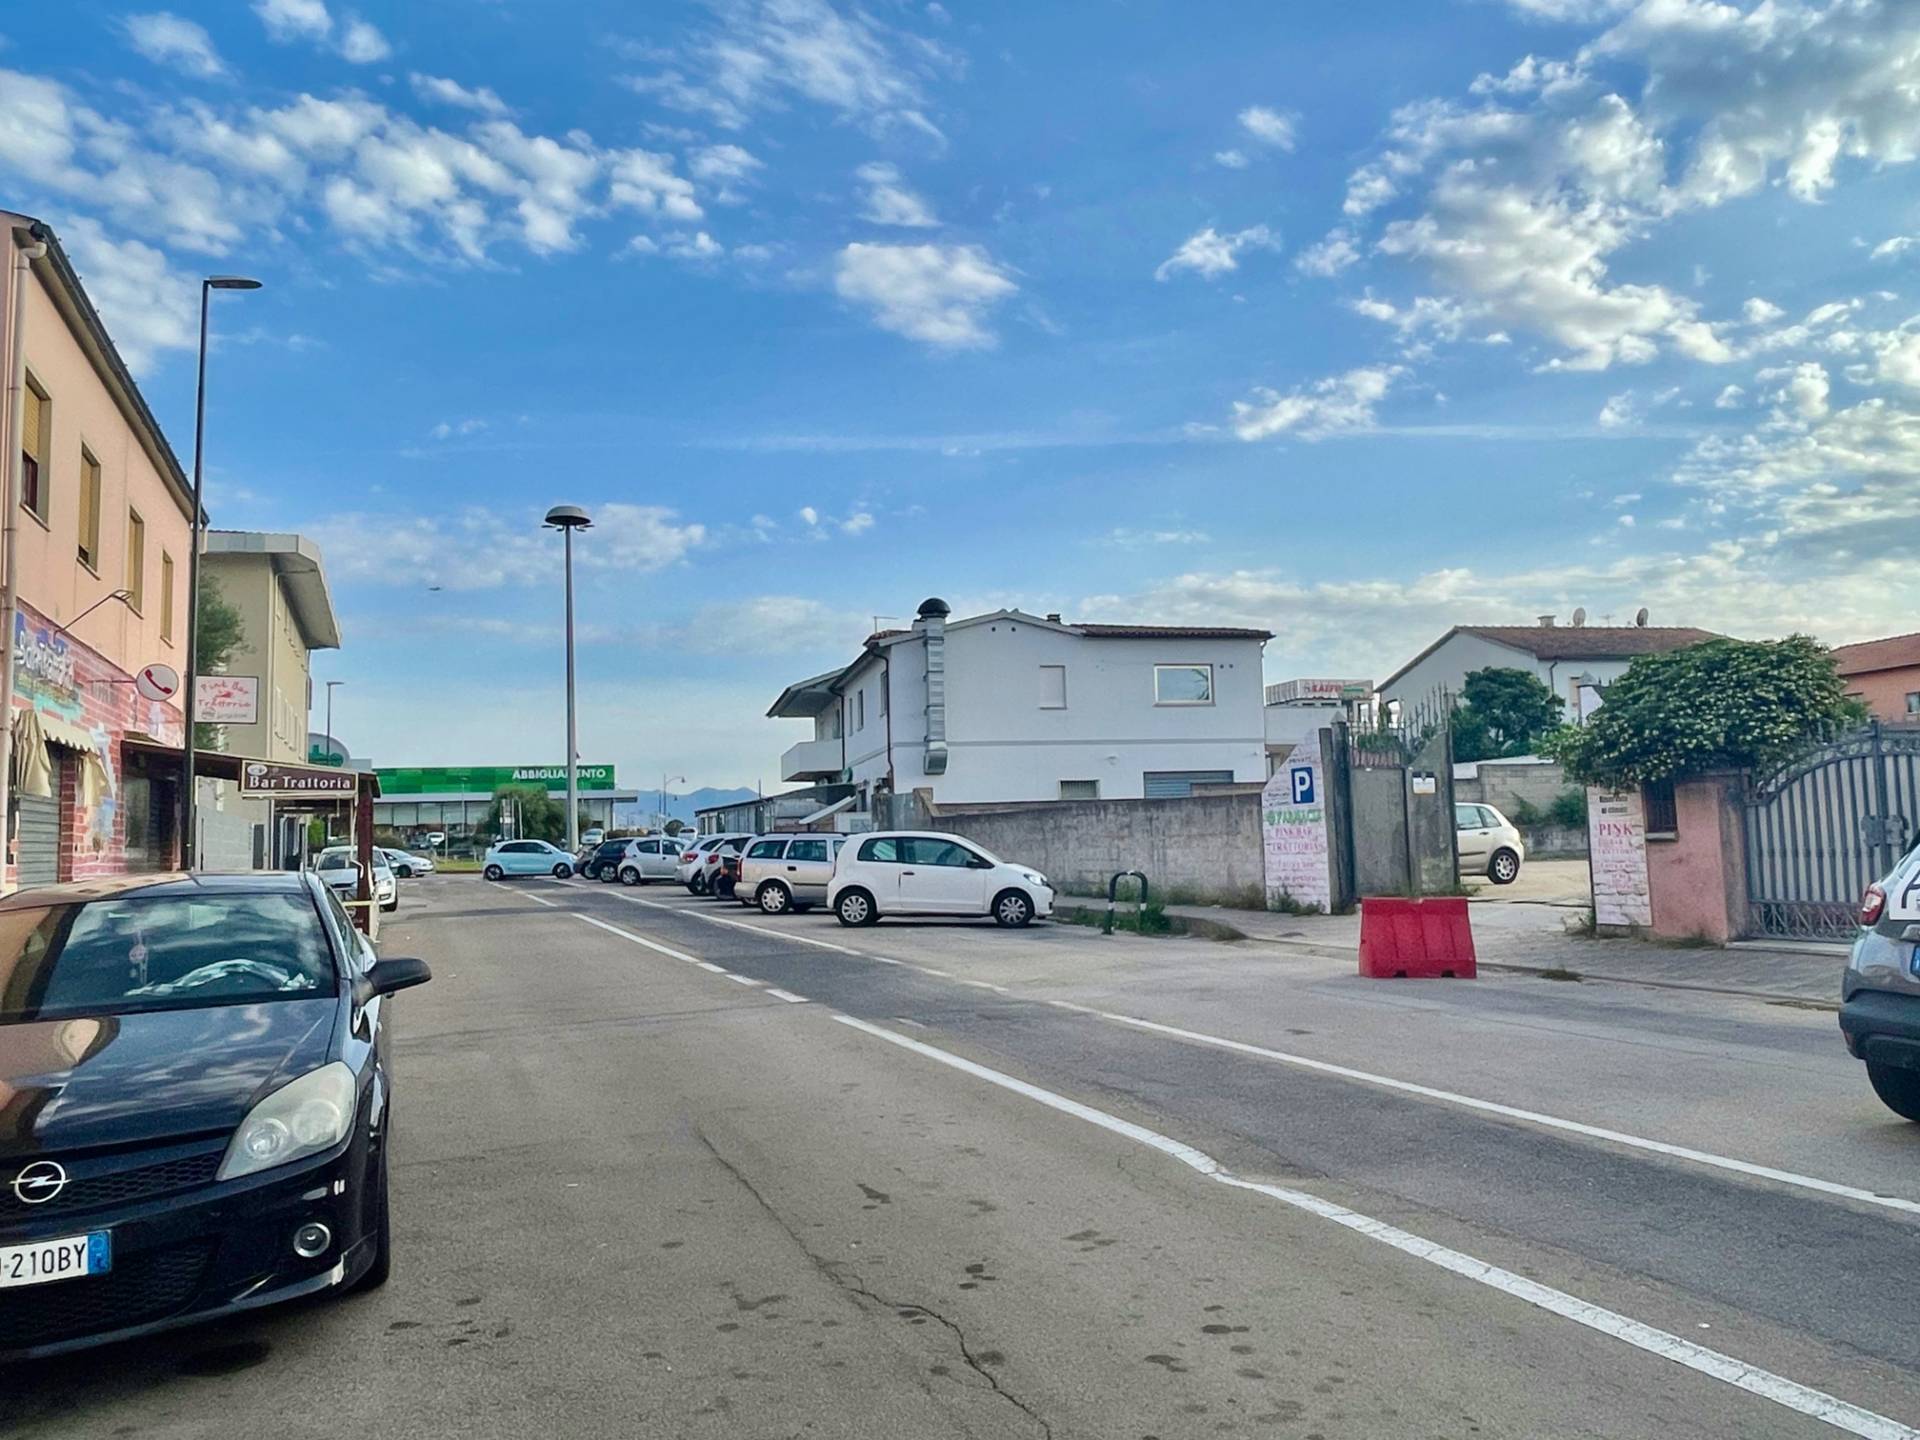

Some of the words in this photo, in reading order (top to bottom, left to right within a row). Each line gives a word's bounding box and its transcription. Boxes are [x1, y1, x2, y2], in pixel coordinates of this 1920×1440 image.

[512, 769, 606, 779] ABBIGLIAENTO
[249, 776, 277, 788] Bar
[282, 776, 351, 789] Trattoria
[1294, 770, 1311, 802] P
[1599, 823, 1633, 835] PINK
